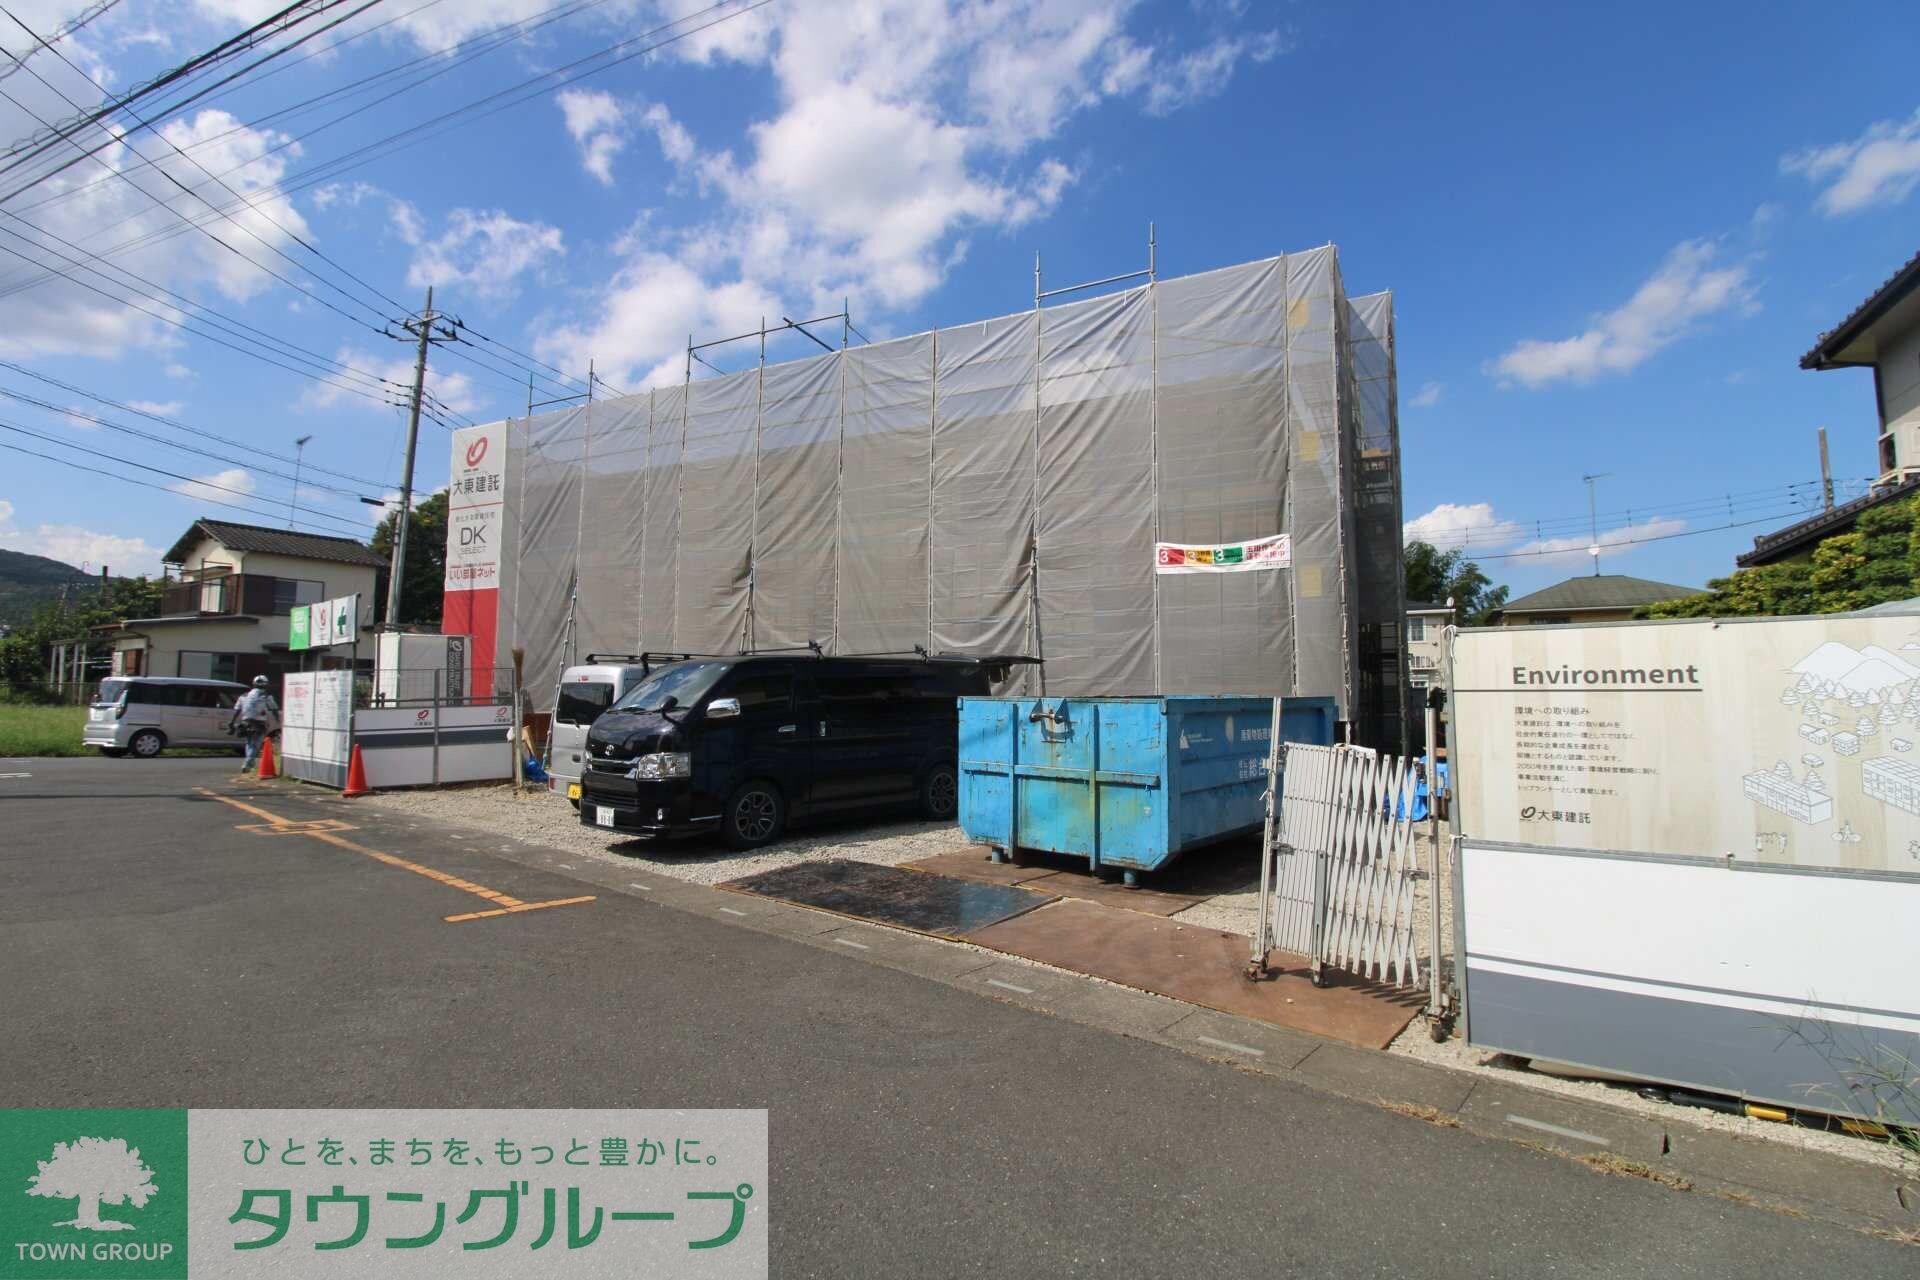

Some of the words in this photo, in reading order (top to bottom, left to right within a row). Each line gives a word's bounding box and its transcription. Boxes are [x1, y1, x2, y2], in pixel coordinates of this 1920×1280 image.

[453, 474, 500, 496] 大東建託
[460, 524, 487, 545] DK
[1513, 665, 1699, 685] Environment
[1515, 706, 1590, 715] 環境への取り組み
[1537, 809, 1591, 824] 大東建託
